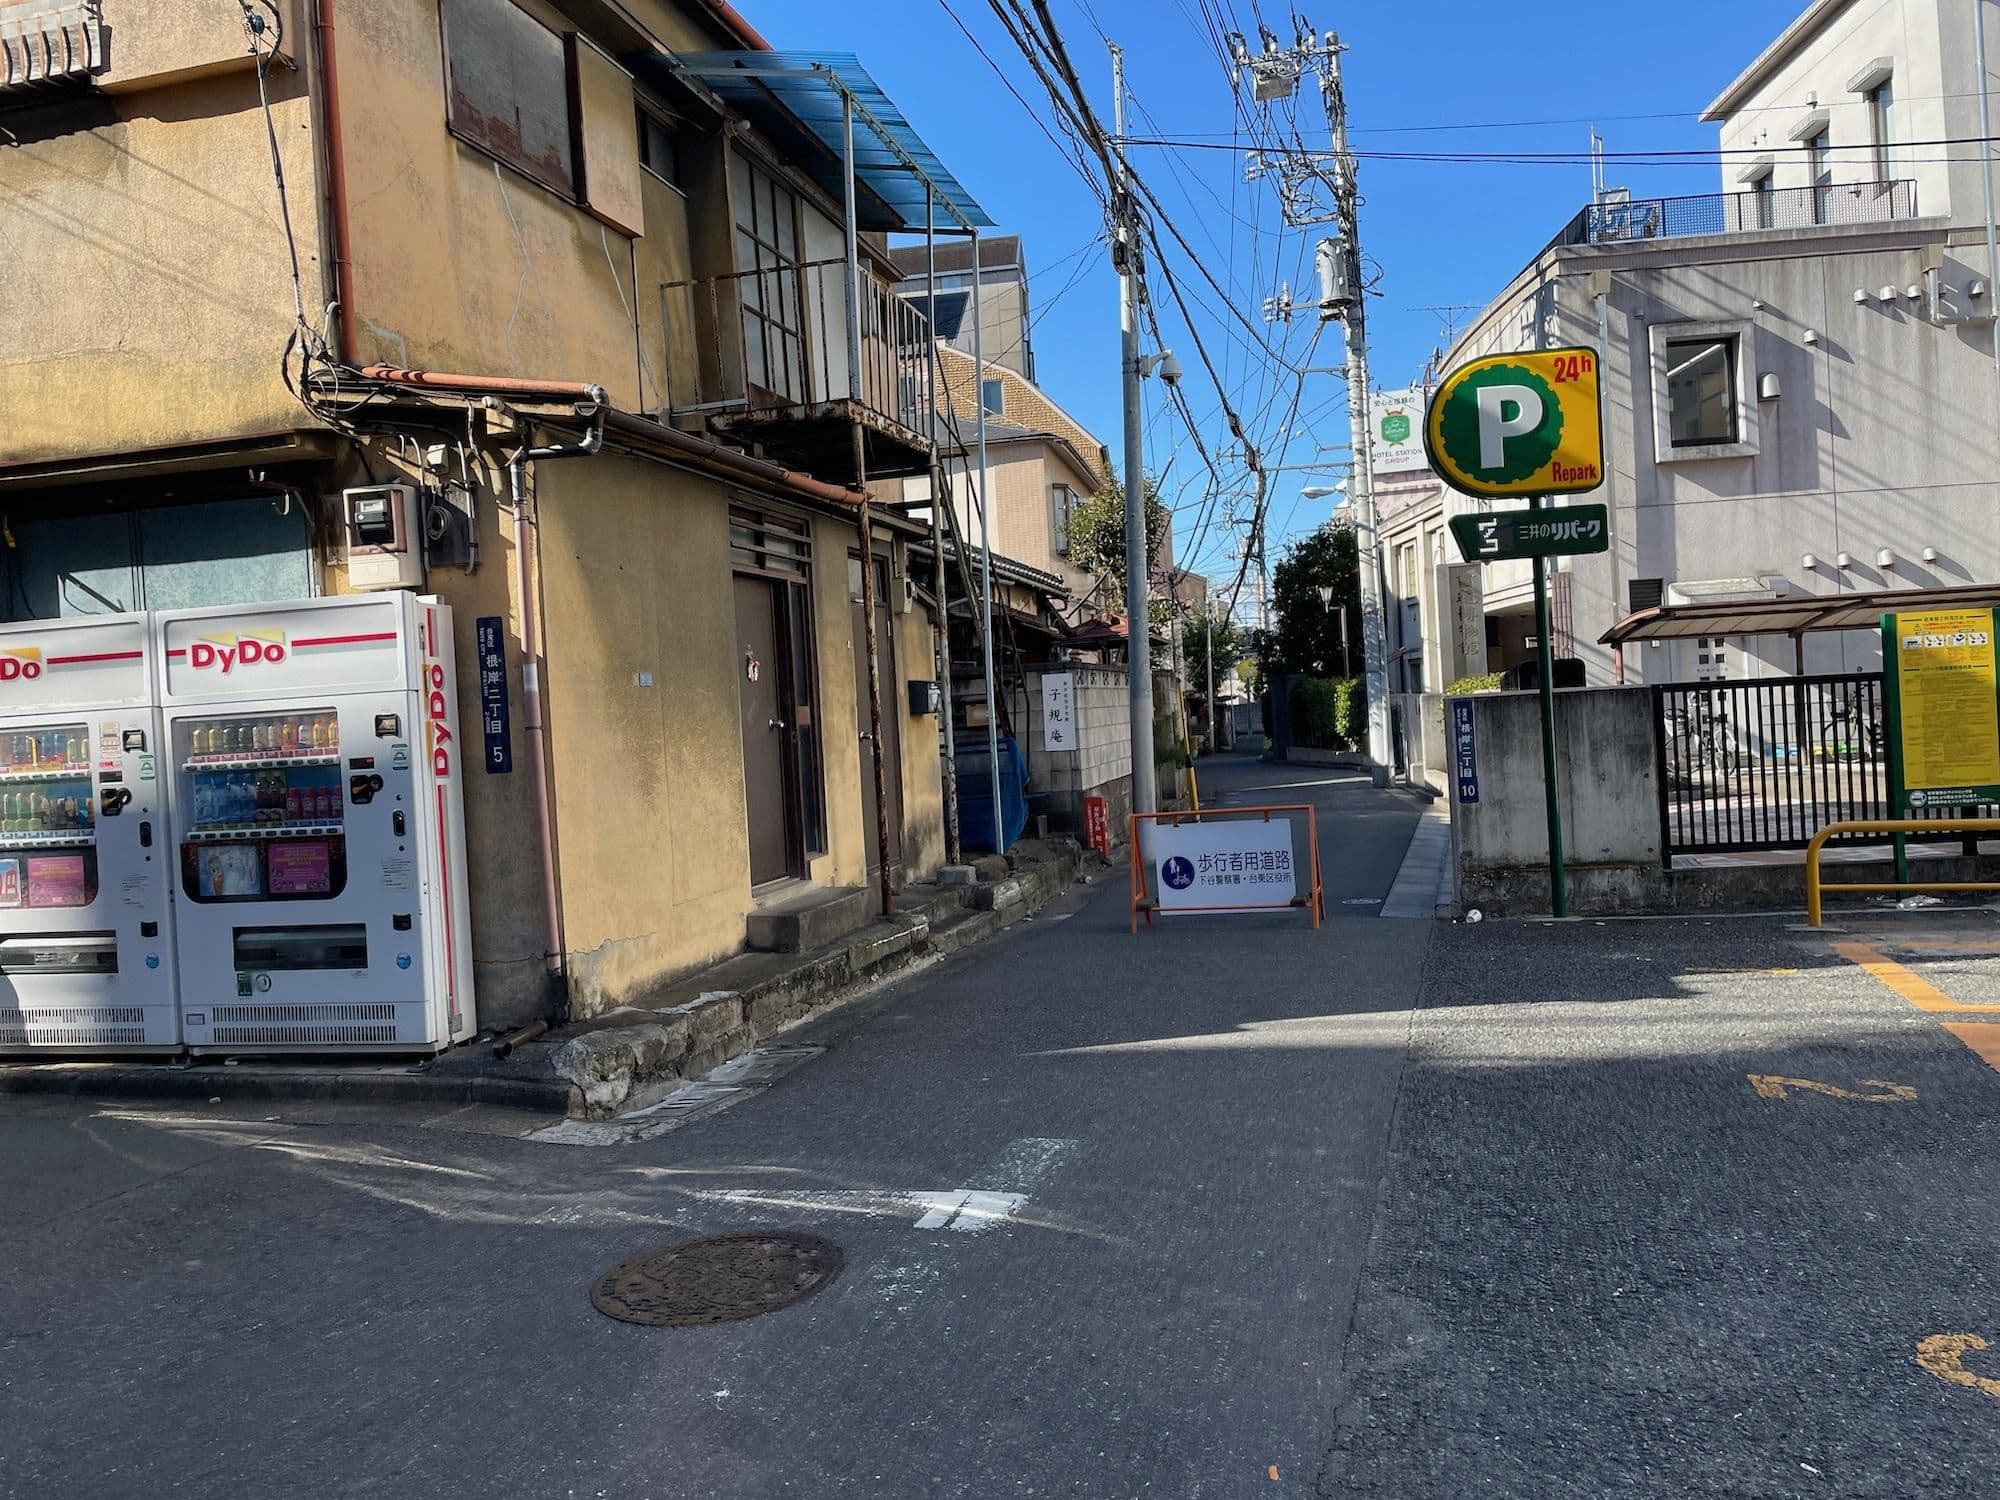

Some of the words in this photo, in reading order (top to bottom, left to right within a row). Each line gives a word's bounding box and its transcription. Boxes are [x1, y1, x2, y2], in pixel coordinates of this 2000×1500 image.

[1553, 355, 1592, 384] 24h
[1476, 384, 1544, 469] P
[1385, 457, 1410, 465] GROUP
[1395, 448, 1423, 457] STATION
[1552, 461, 1597, 484] Repark
[1519, 519, 1601, 541] 三井のリパーク
[191, 640, 285, 673] DyDo
[486, 654, 502, 734] 根岸二丁目
[430, 664, 453, 777] DyDo
[1048, 688, 1063, 744] 子規庵
[494, 746, 503, 763] 5
[1462, 785, 1476, 797] 10
[1198, 850, 1290, 872] 歩行者用道路
